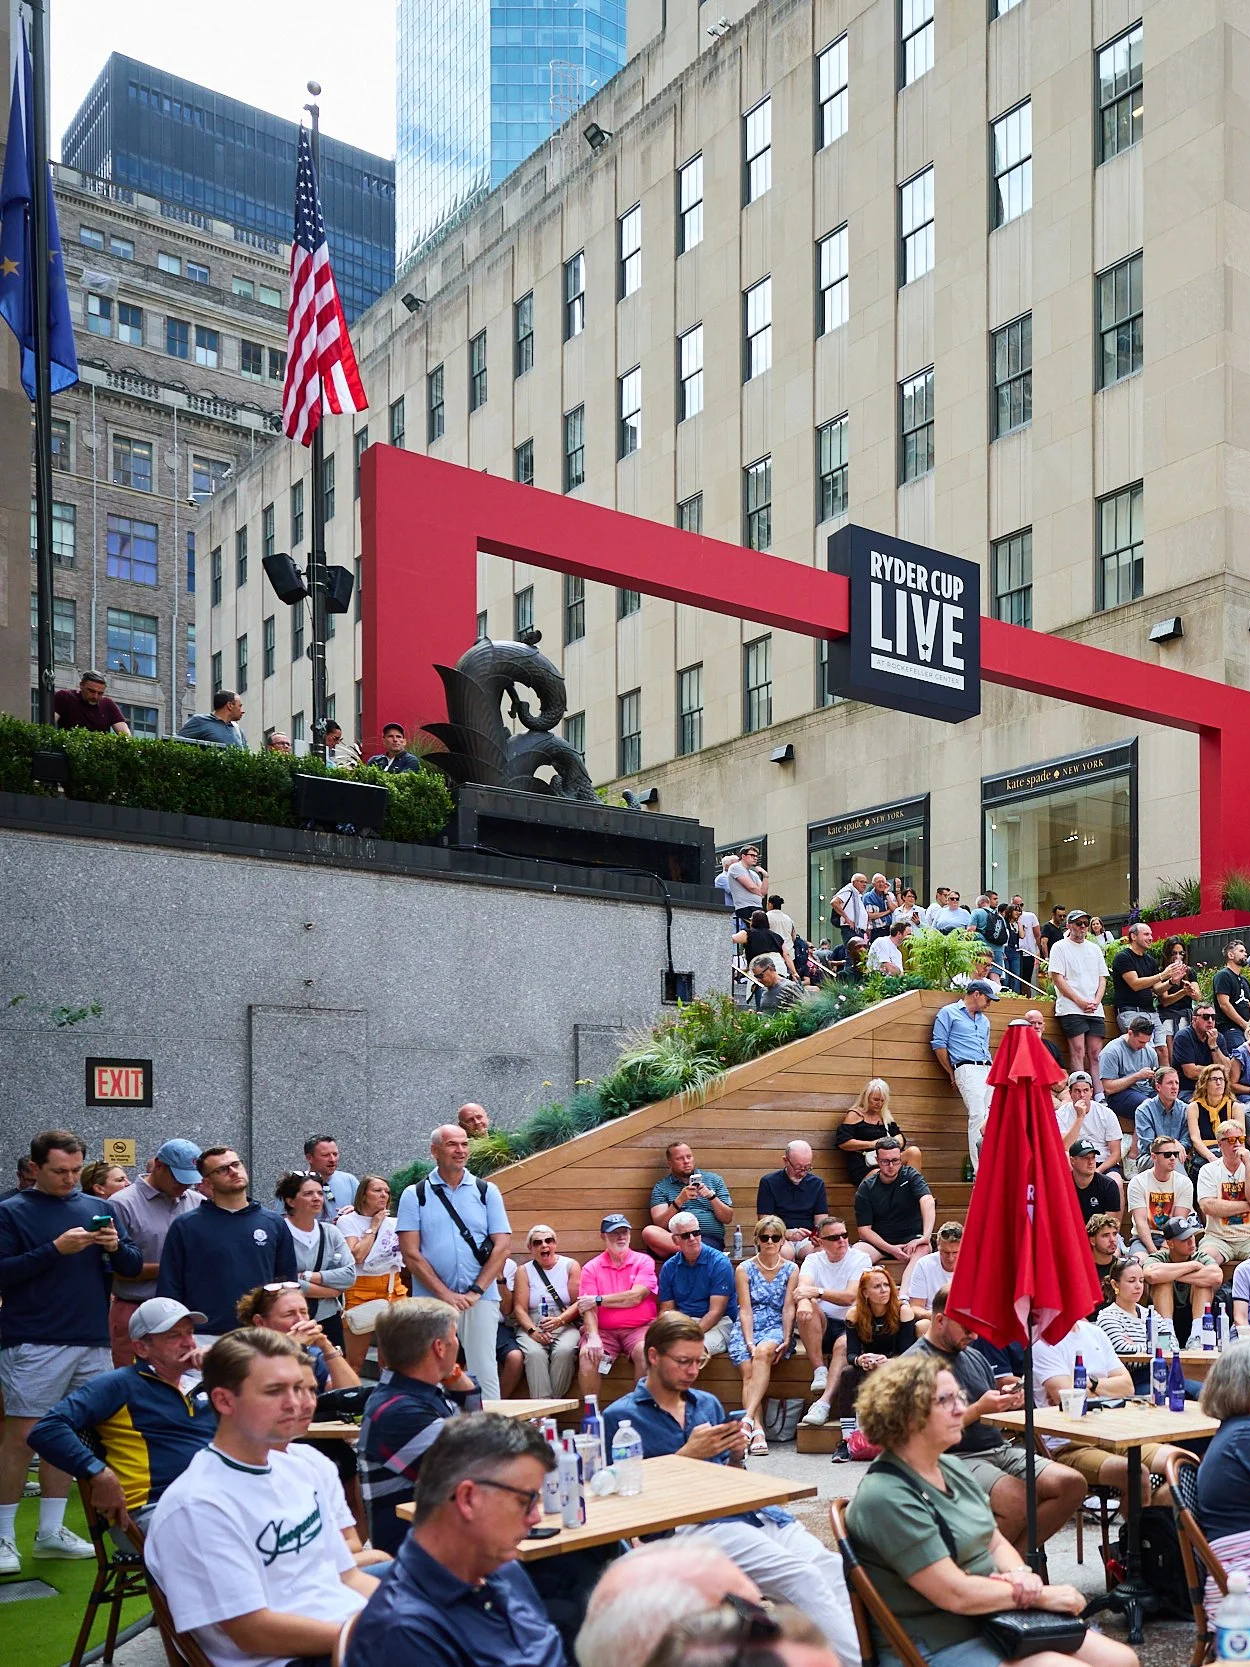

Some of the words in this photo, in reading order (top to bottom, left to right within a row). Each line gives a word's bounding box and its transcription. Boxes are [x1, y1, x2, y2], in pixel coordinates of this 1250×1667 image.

[871, 550, 928, 592] RYDER
[931, 570, 964, 601] CUP
[871, 581, 964, 671] LIVE
[876, 659, 885, 667] AT
[886, 661, 933, 678] ROCKEFELLER
[934, 672, 960, 685] CENTER
[1004, 778, 1024, 790] kate
[1026, 769, 1051, 788] spade
[1062, 765, 1080, 776] NEW
[1082, 758, 1104, 771] YORK
[827, 826, 842, 836] kate
[843, 818, 863, 834] spade
[871, 815, 886, 825] NEW
[887, 810, 904, 821] YORK
[97, 1068, 143, 1098] EXIT
